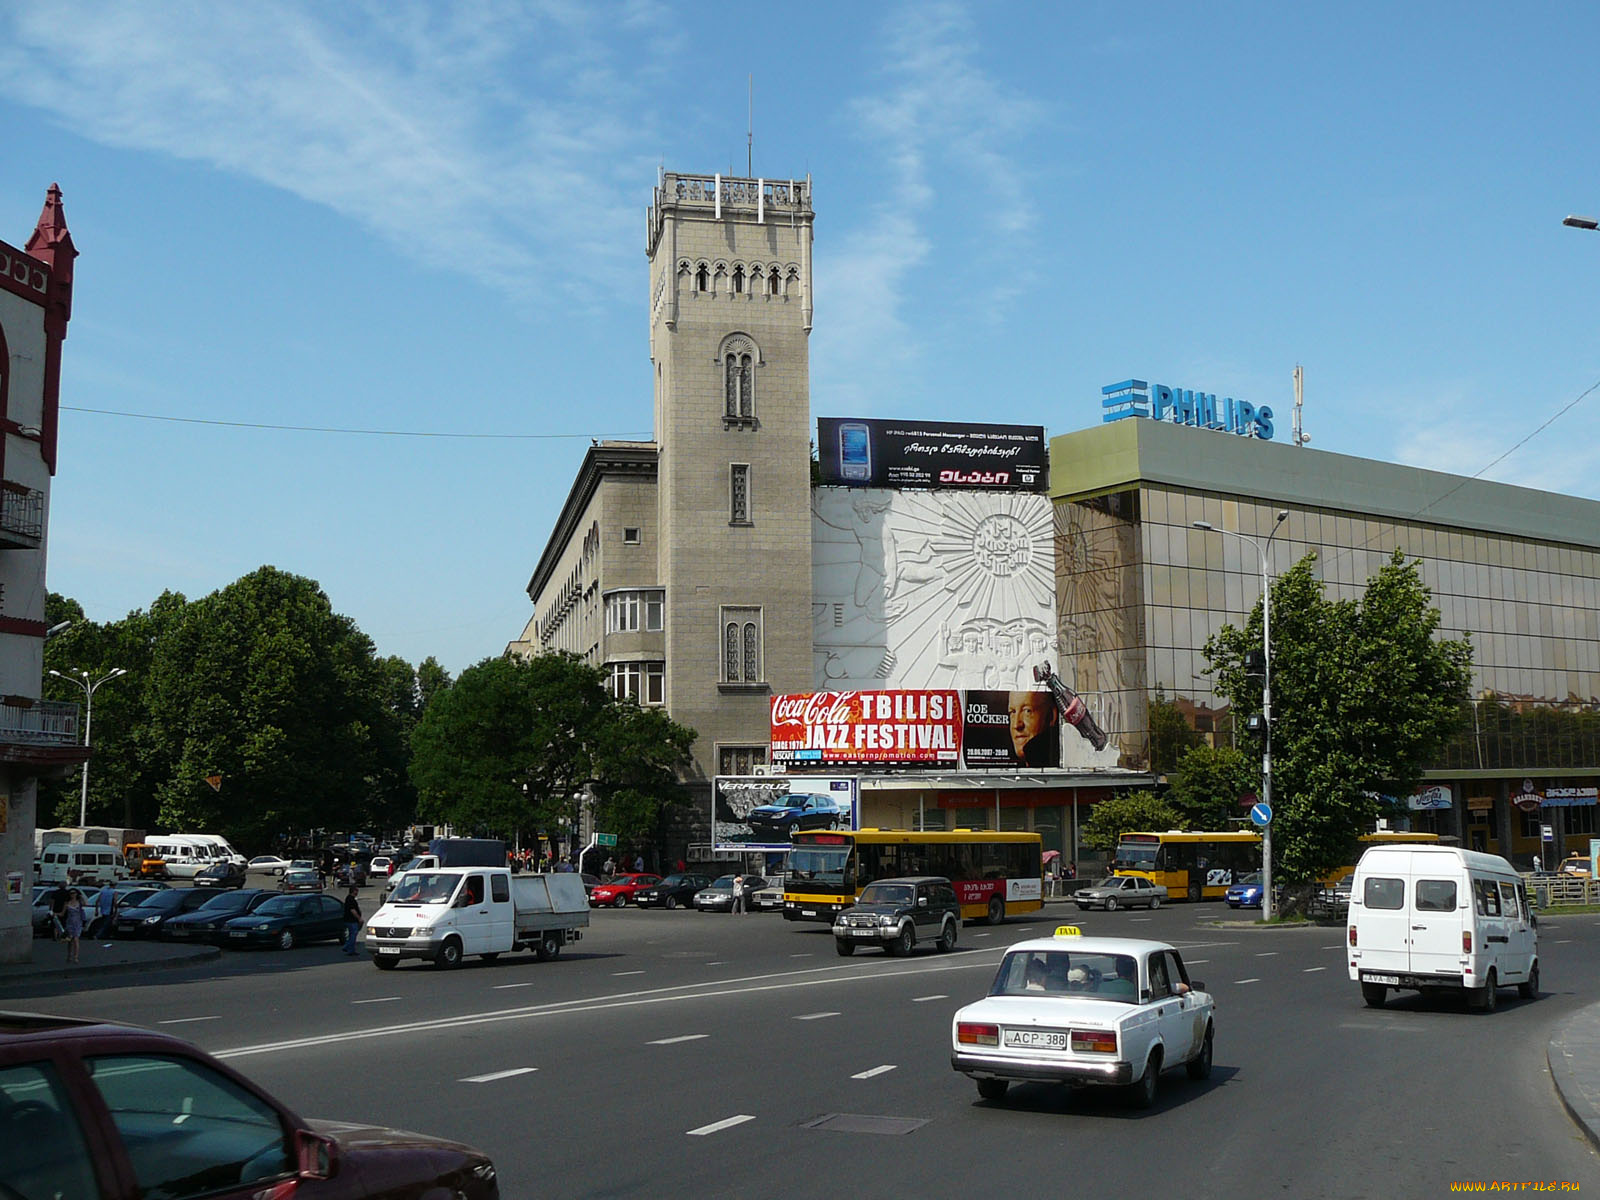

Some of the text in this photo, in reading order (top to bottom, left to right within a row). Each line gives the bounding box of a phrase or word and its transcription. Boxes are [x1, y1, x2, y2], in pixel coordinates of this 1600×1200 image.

[1152, 384, 1274, 440] PHILIPS
[772, 690, 857, 726] Coca-Cola
[860, 695, 953, 720] TBILISI
[967, 704, 988, 714] JOE
[967, 714, 1009, 724] COCKER
[772, 740, 788, 750] SINCE
[805, 724, 956, 749] JAZZ FESTIVAL
[1058, 927, 1077, 935] TAXI
